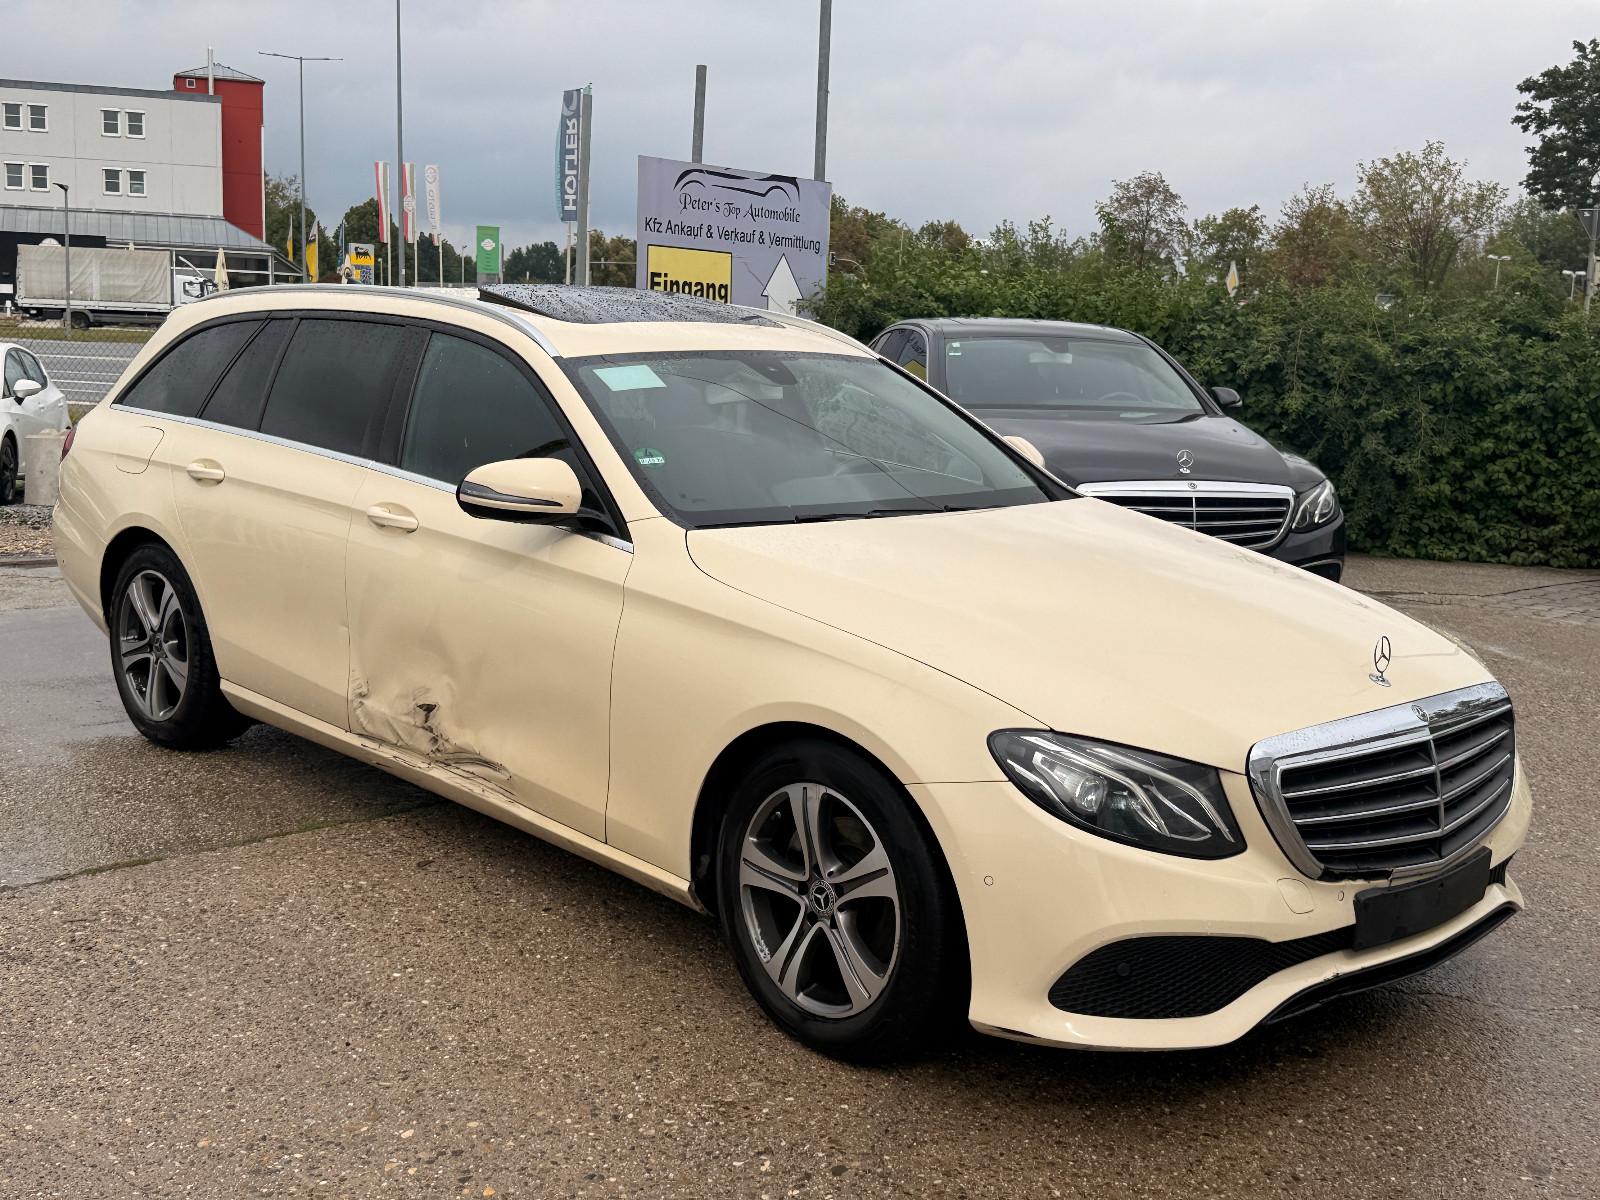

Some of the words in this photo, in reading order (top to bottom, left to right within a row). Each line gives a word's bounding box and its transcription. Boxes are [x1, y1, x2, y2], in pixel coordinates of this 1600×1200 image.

[680, 193, 721, 214] Peter's
[723, 202, 741, 219] Top
[743, 204, 801, 223] Automobile
[644, 217, 663, 233] Kfz
[666, 220, 703, 239] Ankauf
[706, 225, 714, 239] &
[717, 226, 756, 243] Verkauf
[759, 231, 765, 245] &
[769, 231, 821, 254] Vermittlung
[650, 272, 728, 303] Eingang
